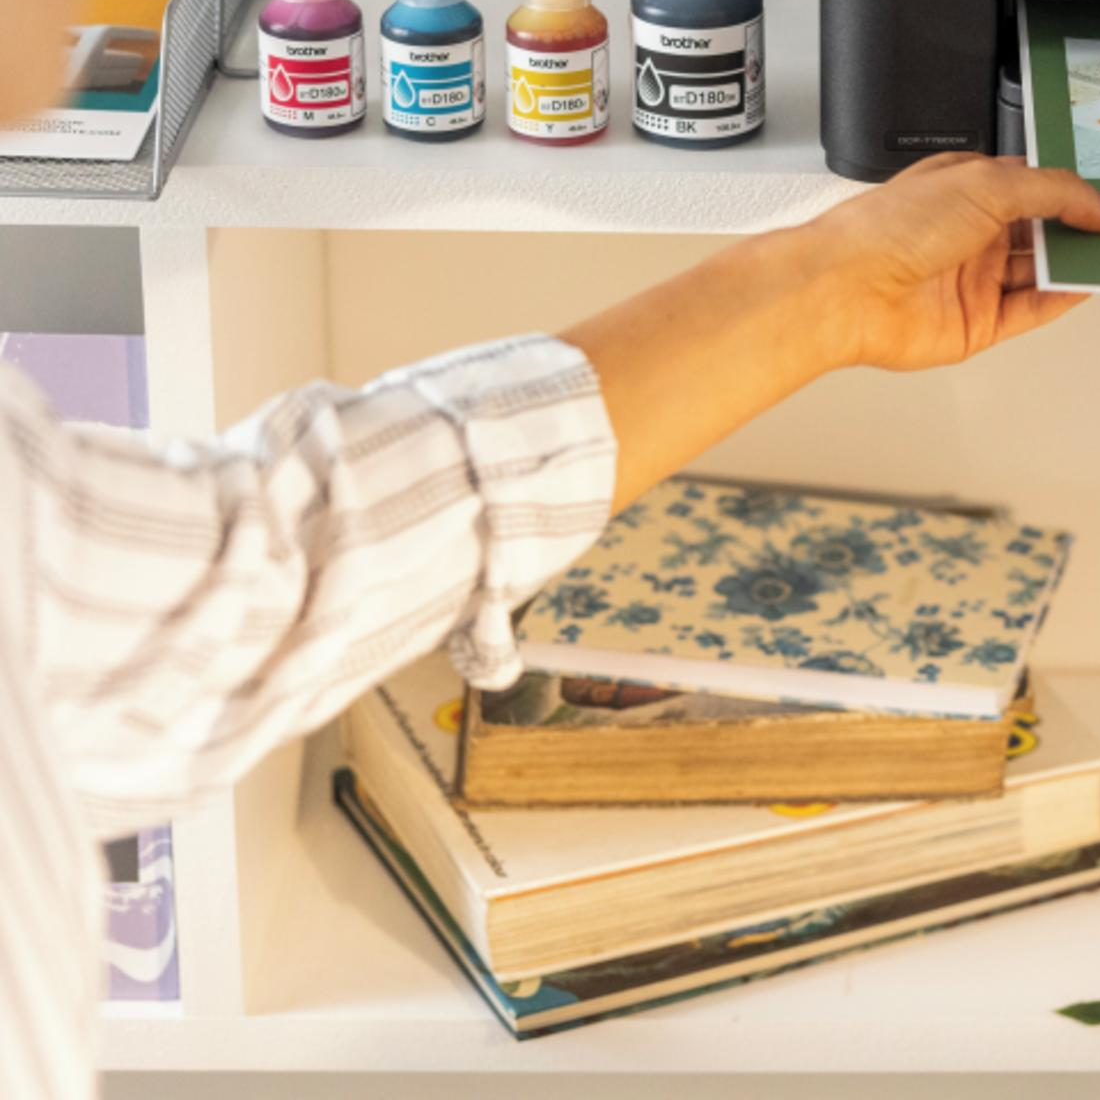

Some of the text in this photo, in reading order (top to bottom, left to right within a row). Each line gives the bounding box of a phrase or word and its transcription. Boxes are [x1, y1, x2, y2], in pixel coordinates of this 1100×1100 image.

[660, 34, 712, 49] brother
[286, 45, 328, 56] brother
[409, 52, 450, 62] brother
[529, 58, 569, 69] brother
[303, 111, 314, 120] M
[425, 116, 437, 126] C
[545, 123, 555, 132] Y
[675, 120, 697, 133] BK
